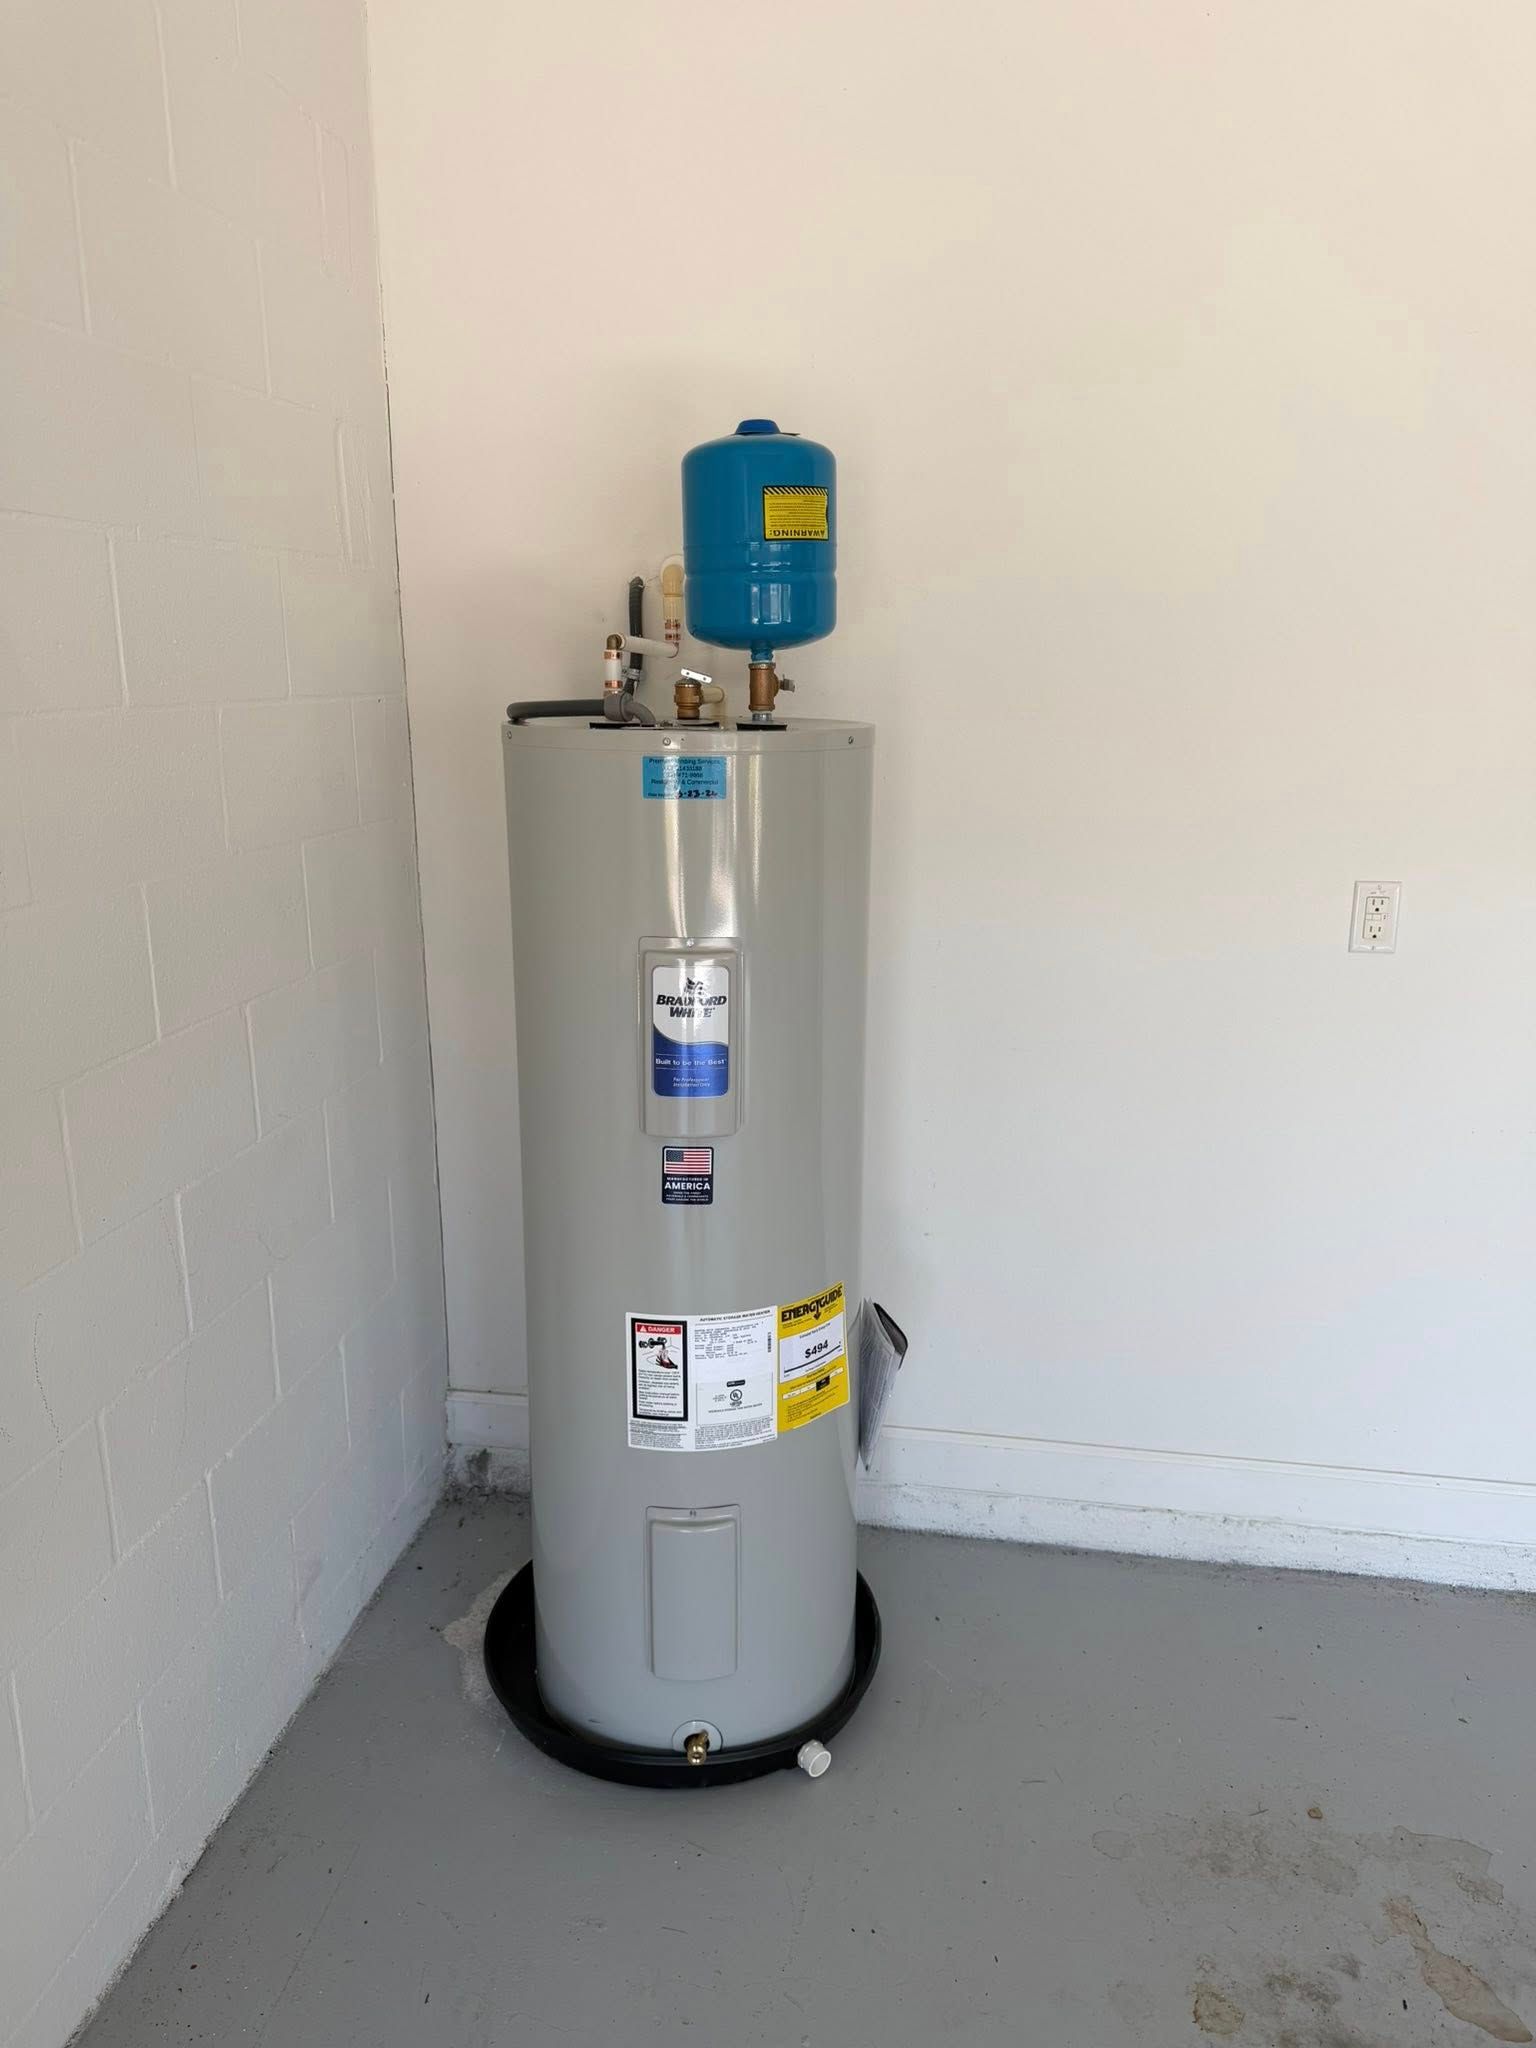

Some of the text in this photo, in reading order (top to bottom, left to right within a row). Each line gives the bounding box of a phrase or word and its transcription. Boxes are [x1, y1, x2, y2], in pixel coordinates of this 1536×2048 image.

[656, 995, 727, 1006] BRADORD
[655, 1058, 671, 1066] Built
[682, 1058, 692, 1066] be
[664, 1181, 711, 1190] AMERICA
[805, 1339, 829, 1359] $494
